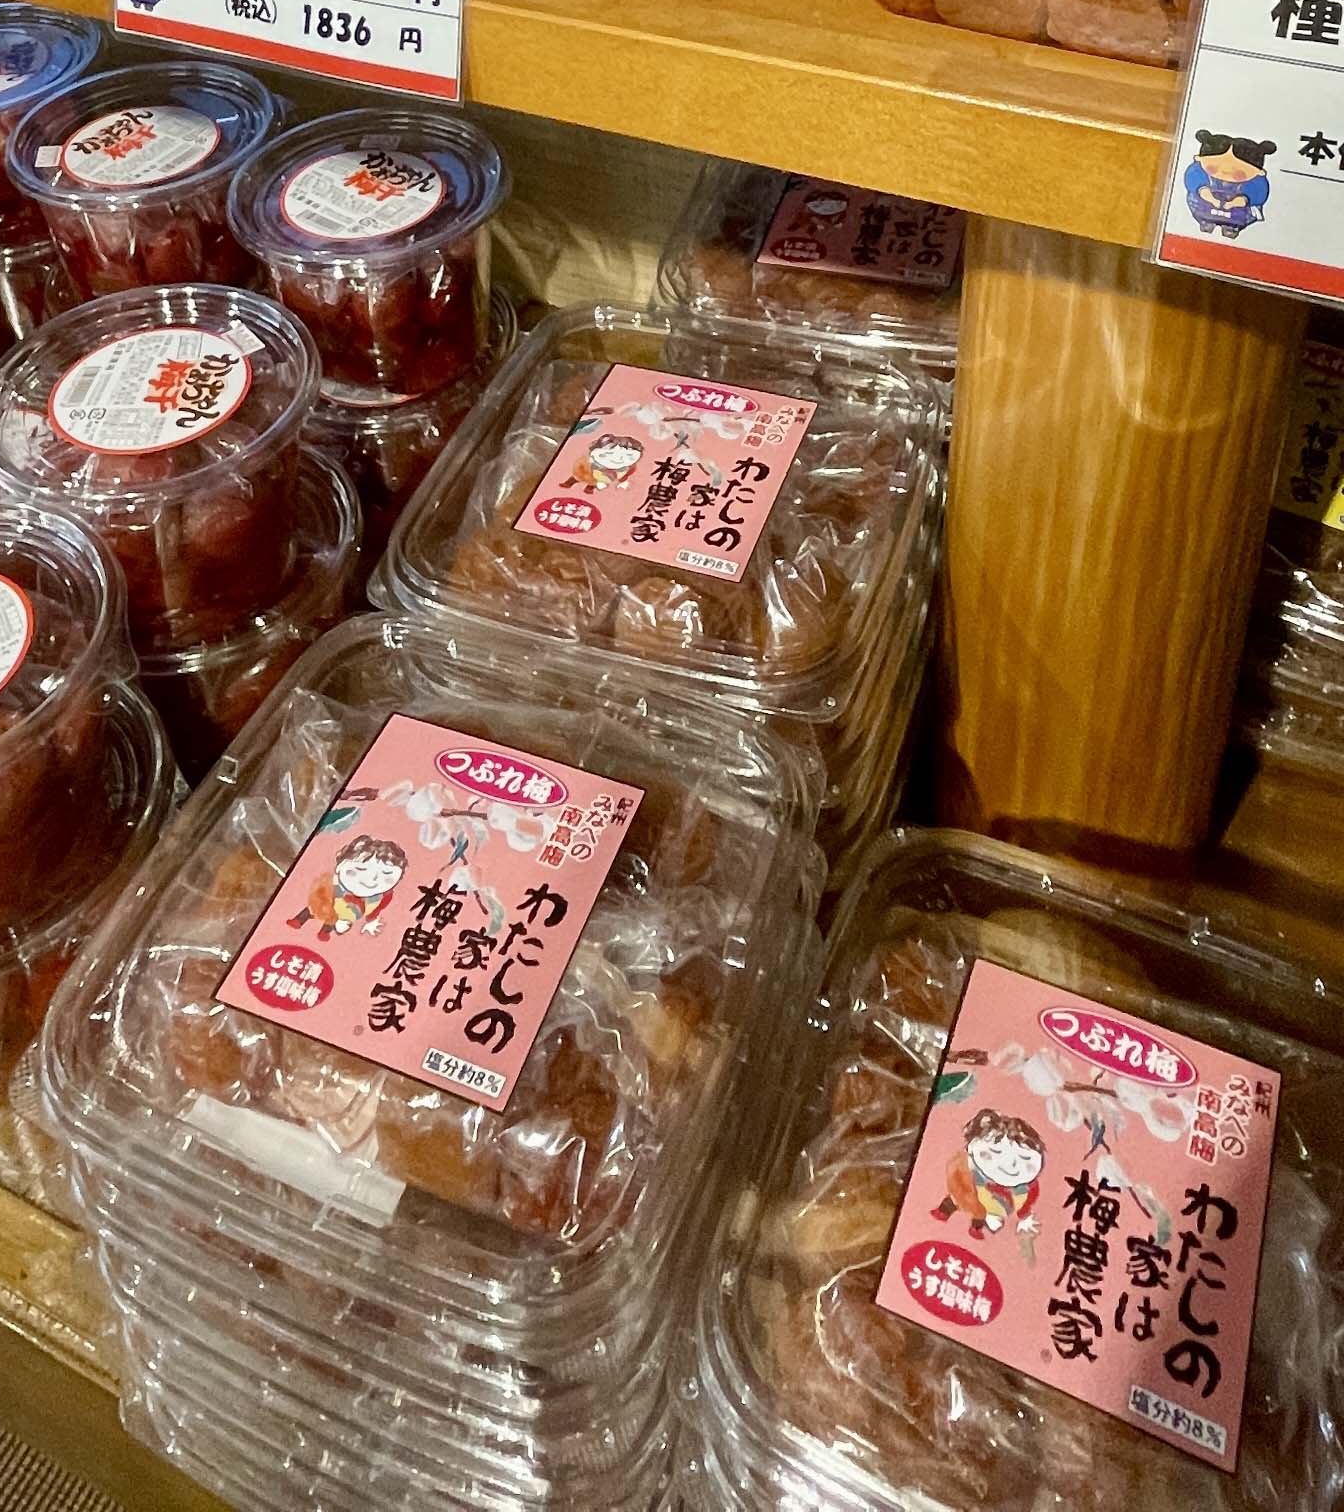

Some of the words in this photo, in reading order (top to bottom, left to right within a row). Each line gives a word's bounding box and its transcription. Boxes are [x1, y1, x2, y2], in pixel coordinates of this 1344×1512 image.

[303, 4, 372, 46] 1836
[399, 27, 423, 54] 円
[662, 384, 748, 413] つぶれ梅
[629, 456, 694, 544] 梅農家
[674, 483, 721, 531] 家は
[703, 456, 770, 552] わたしの
[677, 551, 737, 575] 塩分約8%
[444, 751, 556, 804] つぶれ梅
[538, 805, 586, 867] 南高梅
[366, 878, 469, 1035] 梅農家
[429, 928, 498, 1014] 家は
[463, 882, 569, 1055] わたしの
[424, 1050, 506, 1094] 塩分約8%
[1048, 1011, 1182, 1084] つぶれ梅
[923, 1245, 986, 1289] しそ漬
[1046, 1168, 1123, 1364] 梅農家
[1113, 1234, 1173, 1342] 家は
[1163, 1182, 1239, 1398] わたしの
[907, 1271, 992, 1324] うす塩味梅
[1130, 1389, 1225, 1451] 塩分約8%
